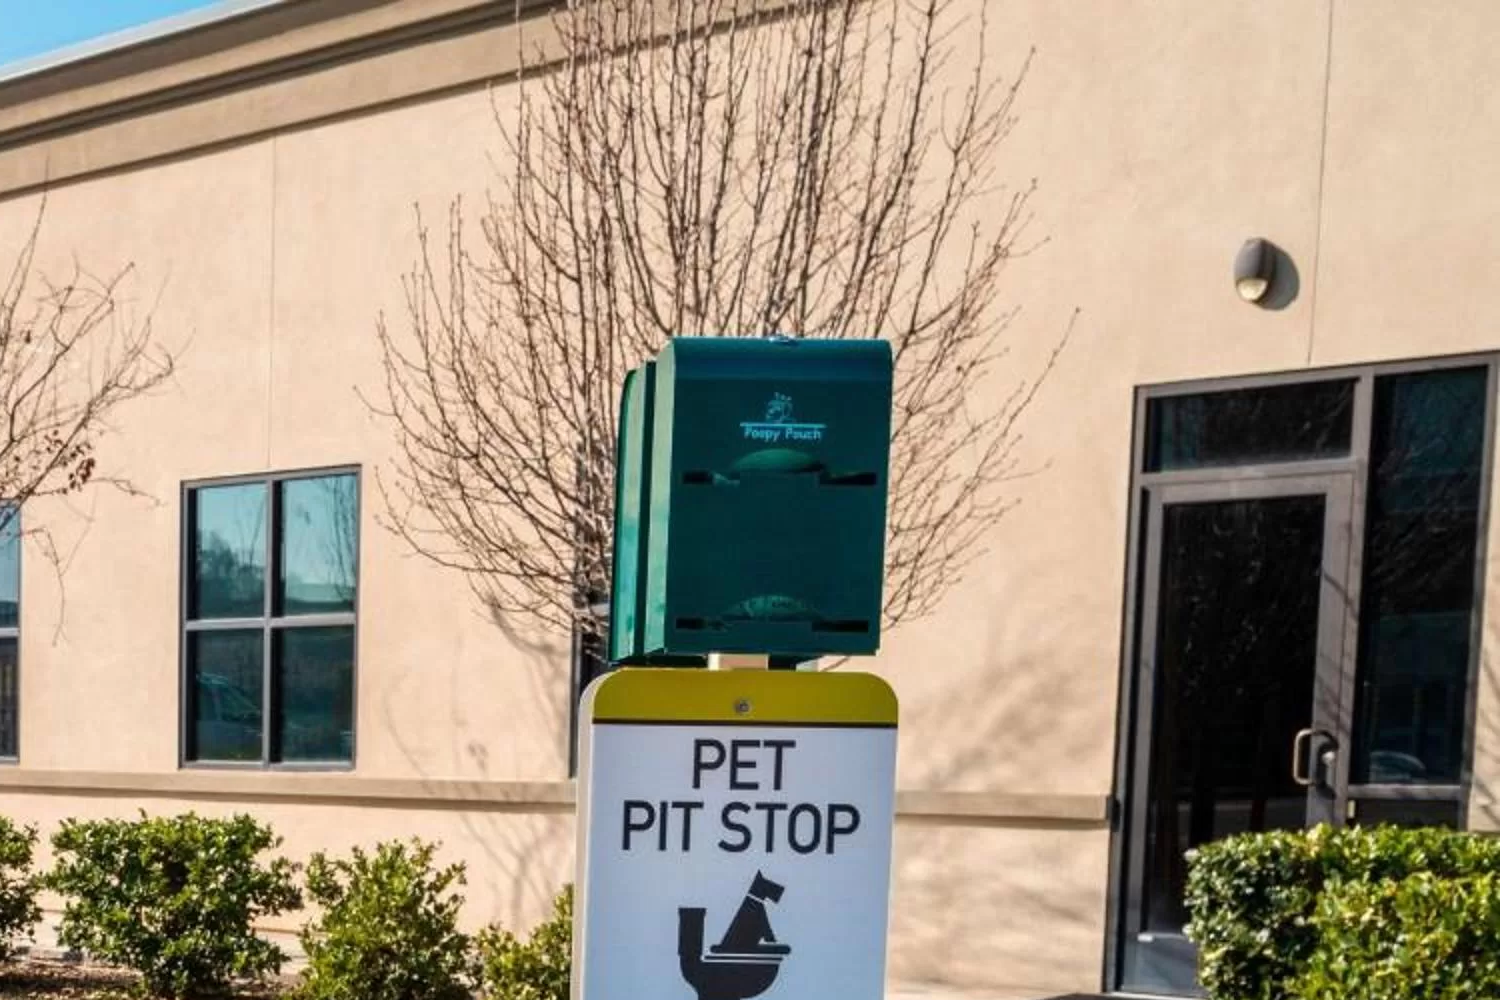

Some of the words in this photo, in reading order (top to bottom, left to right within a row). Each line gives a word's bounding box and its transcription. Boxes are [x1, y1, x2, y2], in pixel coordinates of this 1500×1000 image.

[785, 427, 822, 440] Pouch
[692, 739, 796, 790] PET
[622, 800, 704, 852] PIT
[718, 802, 861, 855] STOP
